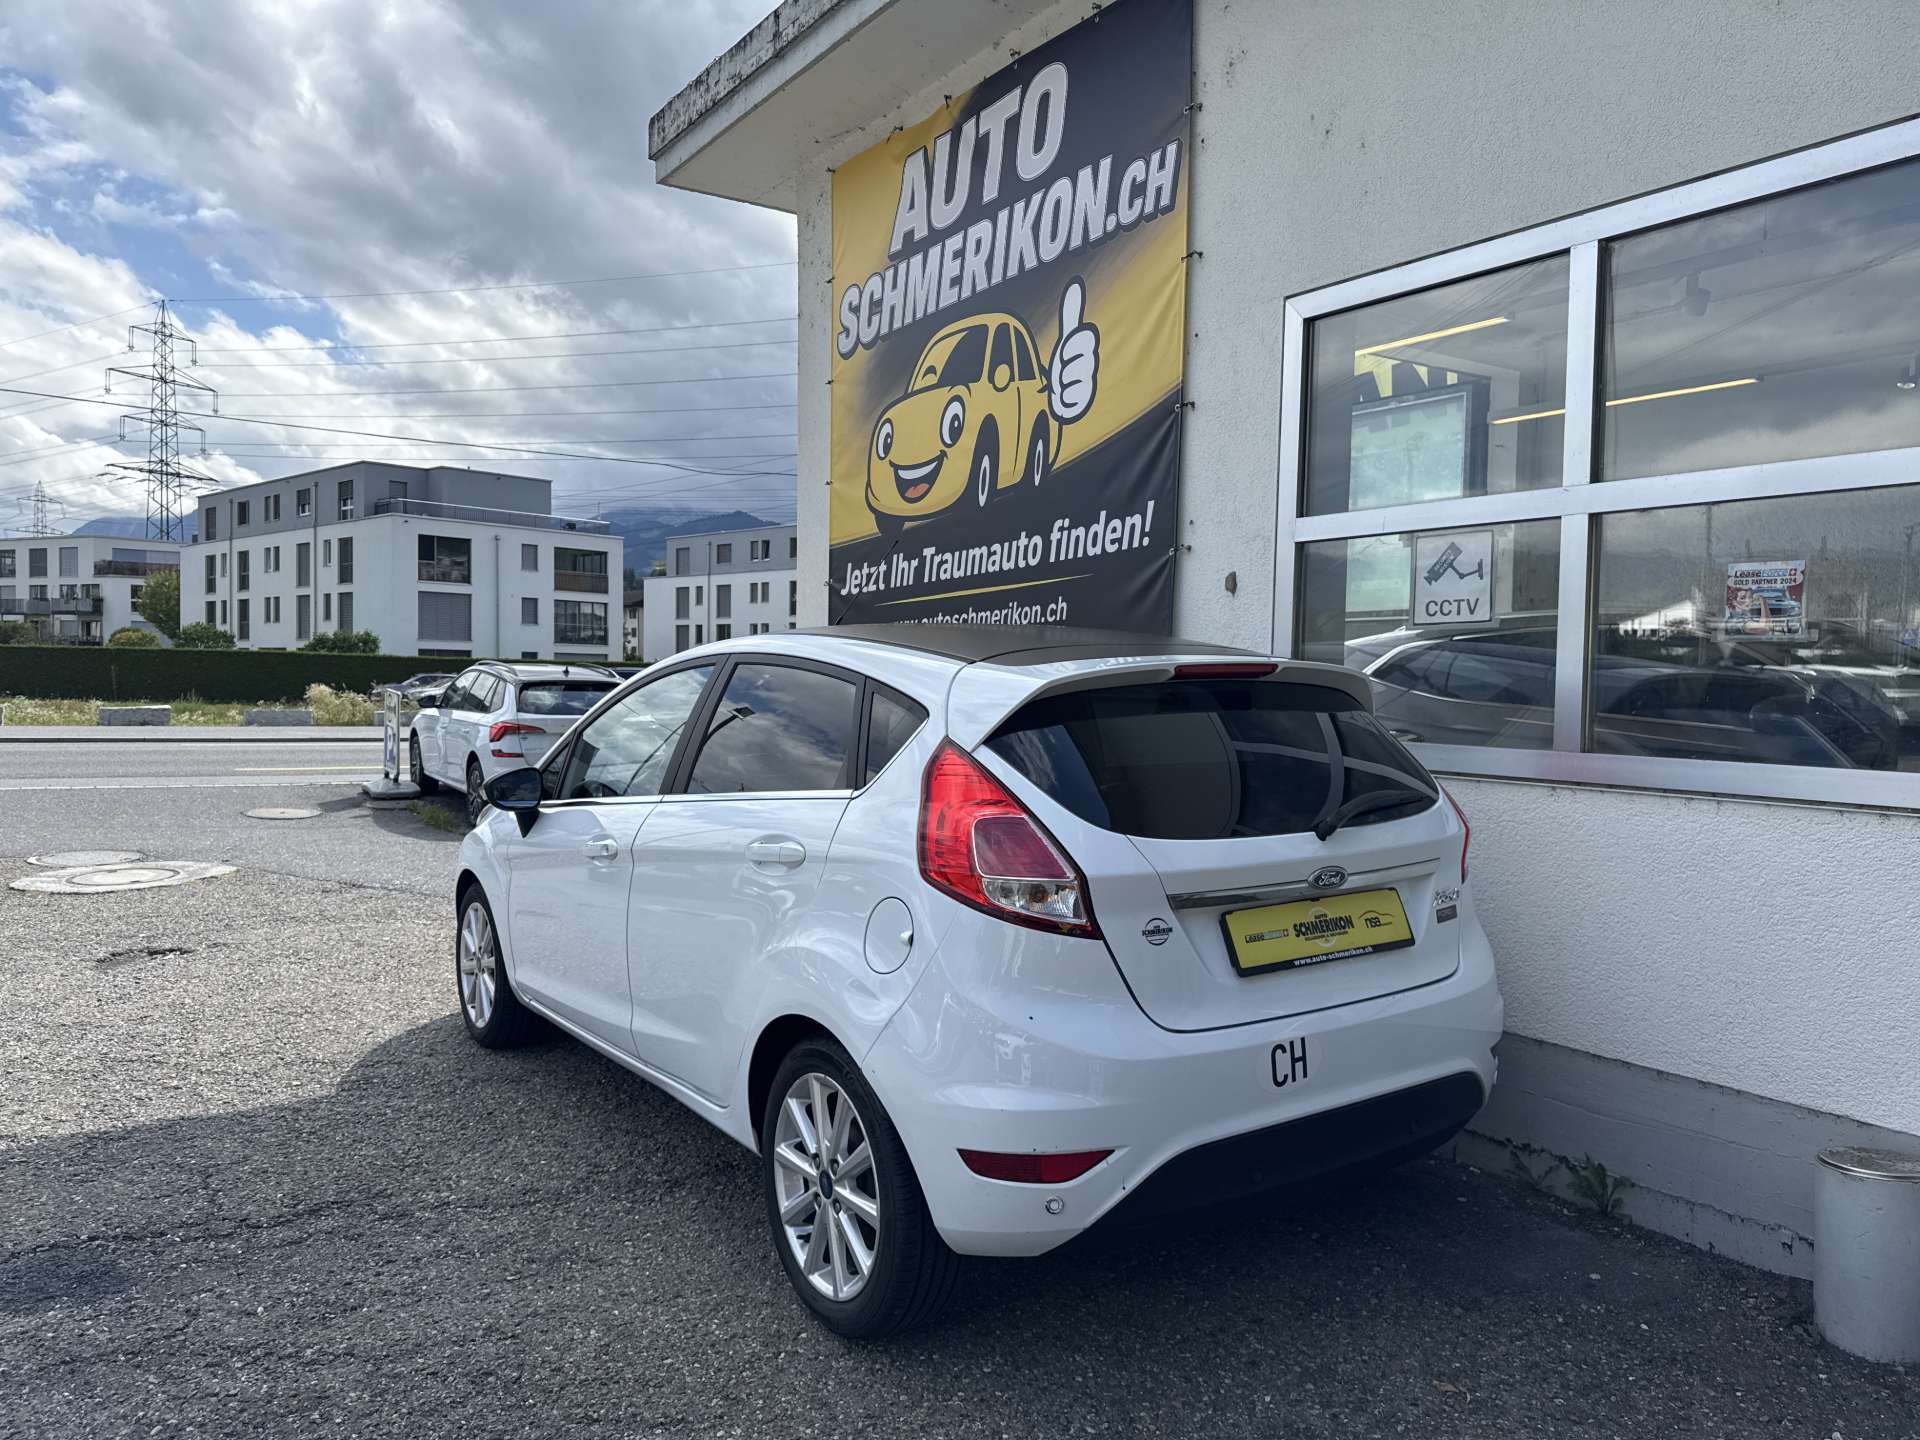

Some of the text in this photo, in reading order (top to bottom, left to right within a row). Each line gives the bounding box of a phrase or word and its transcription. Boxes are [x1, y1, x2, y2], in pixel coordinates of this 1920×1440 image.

[888, 61, 1069, 256] AUTO
[837, 138, 1179, 356] SCHMERIKON.CH
[840, 500, 1155, 597] Jetzt Ihr Traumauto finden!
[1751, 578, 1778, 586] PARTNER
[895, 596, 1067, 625] toschmerikon.ch
[1425, 598, 1480, 617] CCTV
[1319, 871, 1341, 886] Ford
[1293, 915, 1355, 938] SCHMERIKON
[1364, 916, 1382, 929] nsa
[1271, 1036, 1308, 1088] CH
